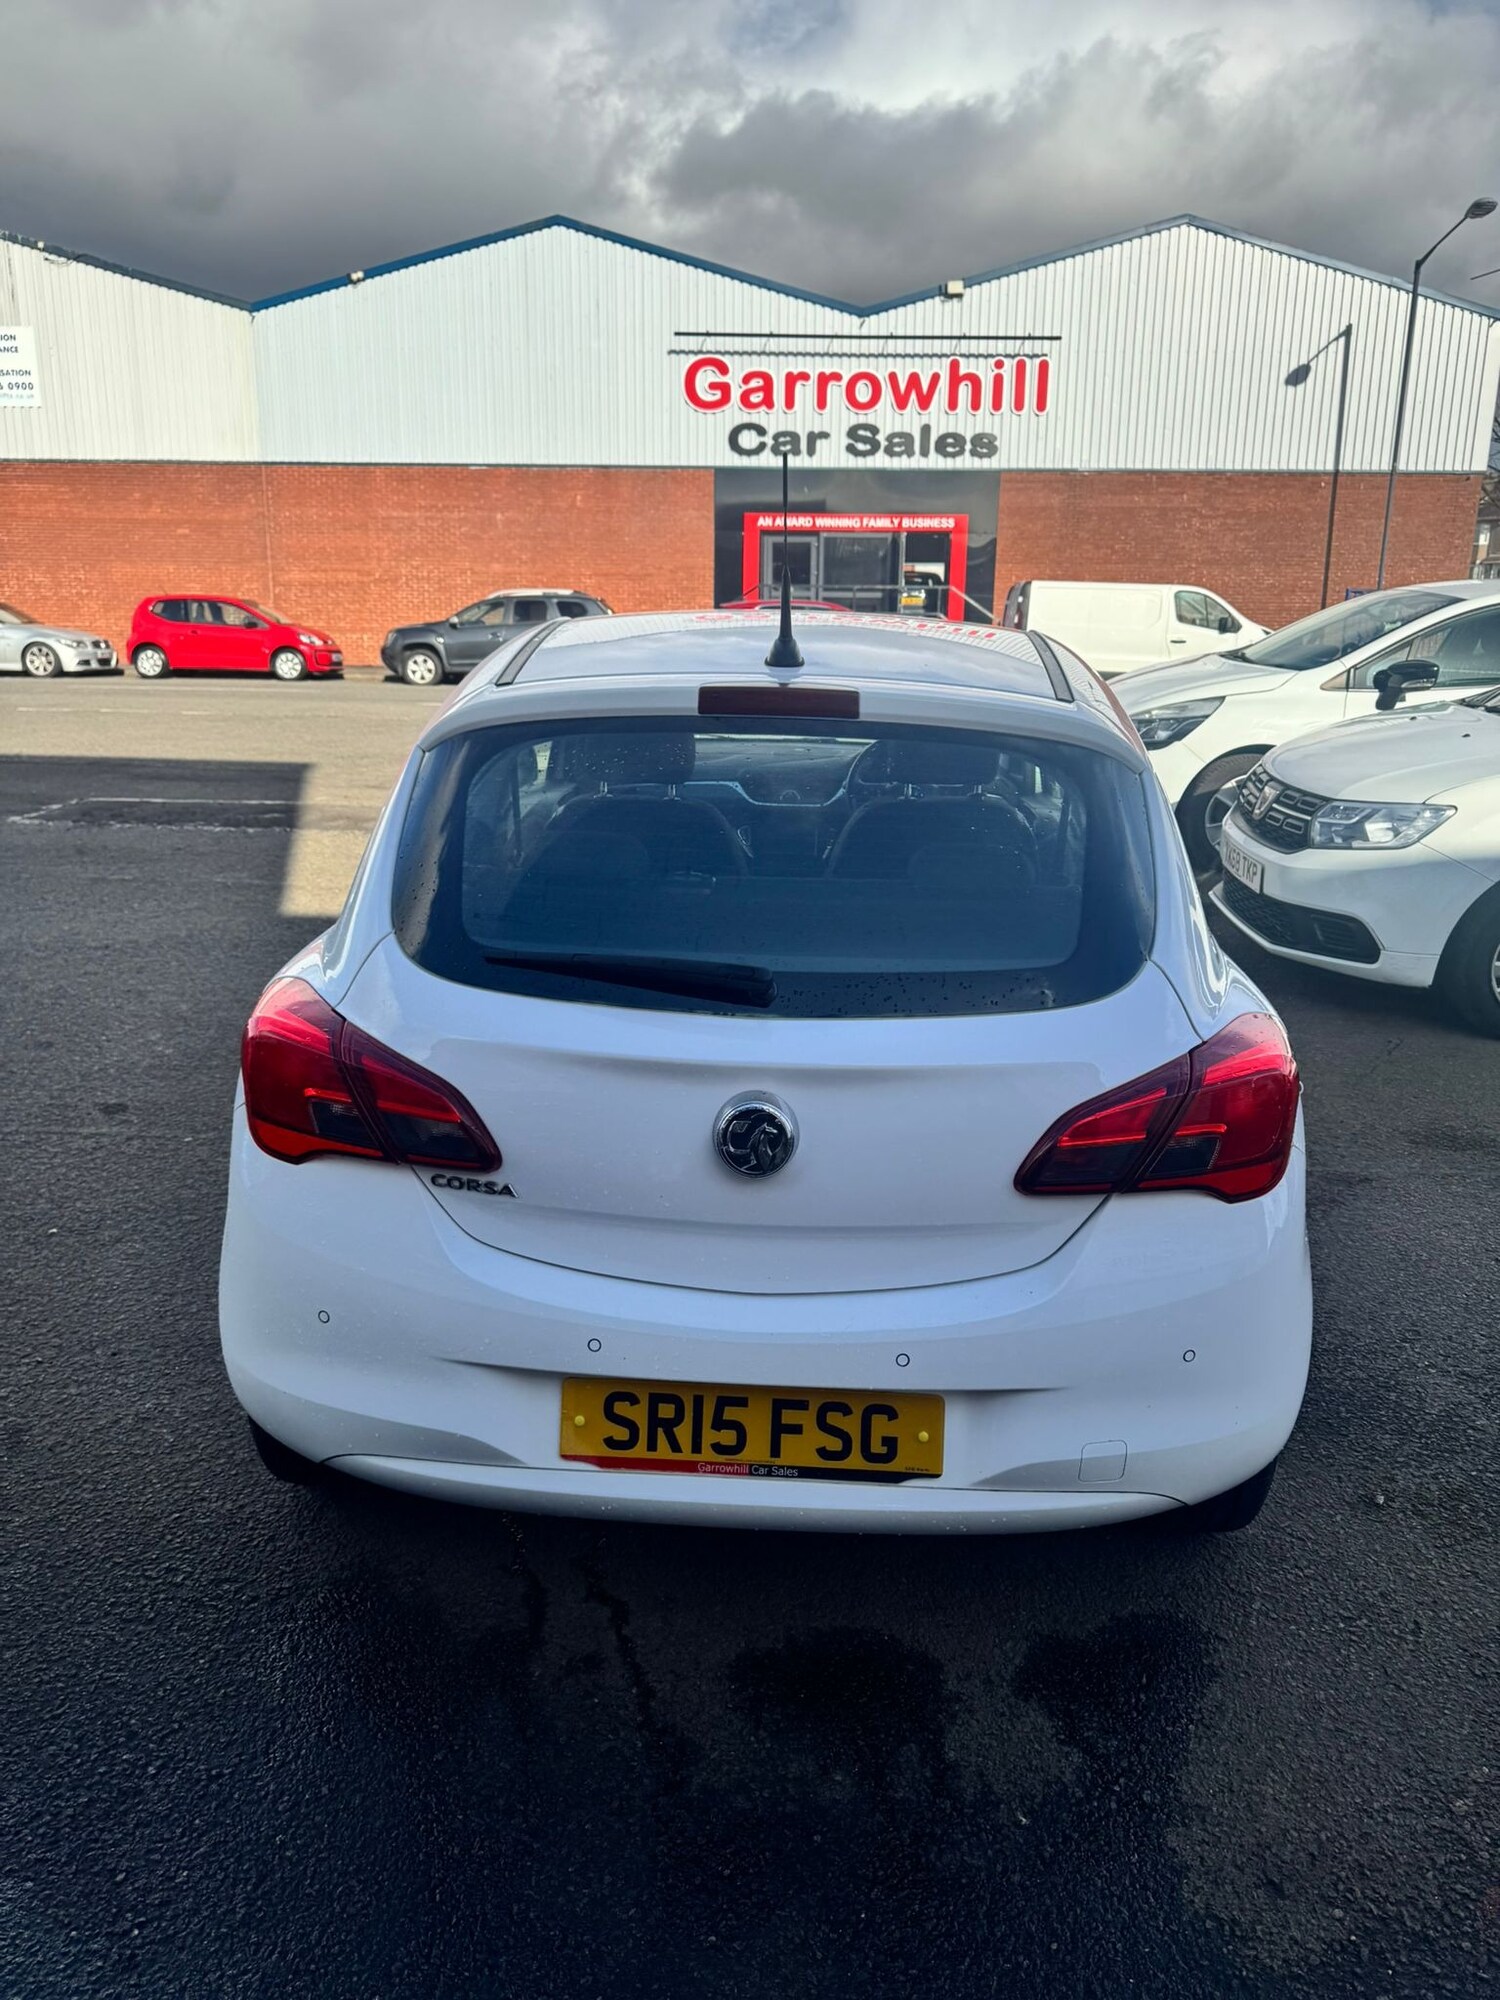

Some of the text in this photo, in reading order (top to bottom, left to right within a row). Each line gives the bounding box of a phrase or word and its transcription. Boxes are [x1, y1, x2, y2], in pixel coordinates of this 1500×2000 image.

[7, 382, 34, 390] 0900
[684, 355, 1050, 415] Garrowhill
[728, 422, 999, 458] Car Sales
[757, 516, 955, 528] AN AWARD WINNING FAMILY BUSINESS
[1242, 855, 1258, 884] TKP
[430, 1173, 519, 1198] CORSA
[602, 1391, 899, 1465] SR15 FSG
[697, 1462, 799, 1477] Garrowhill Car Sales
